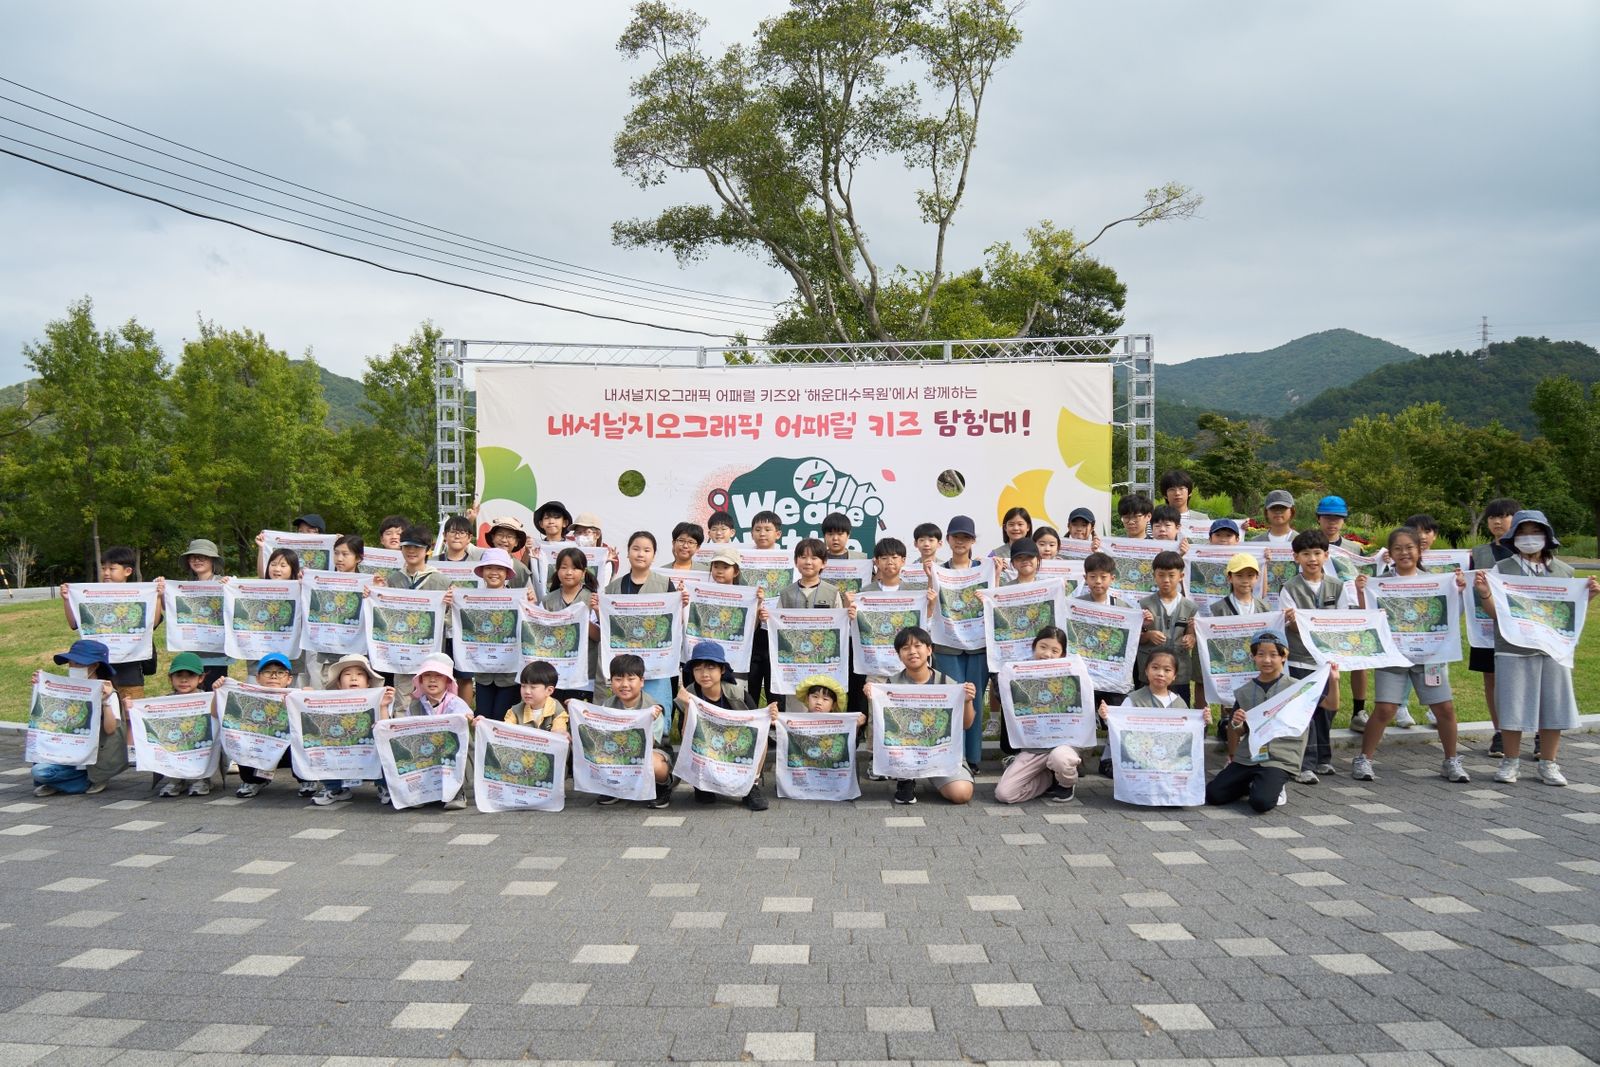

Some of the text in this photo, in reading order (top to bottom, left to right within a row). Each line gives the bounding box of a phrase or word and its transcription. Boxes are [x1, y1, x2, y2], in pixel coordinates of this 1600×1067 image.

[604, 388, 711, 403] 내셔널지오그래픽
[715, 388, 756, 403] 어패럴
[760, 388, 801, 403] 키즈와
[923, 385, 978, 400] 함께하는
[547, 408, 1031, 440] 내셔널지오그래픽 어패럴 키즈 탐험대!
[731, 490, 865, 529] We are
